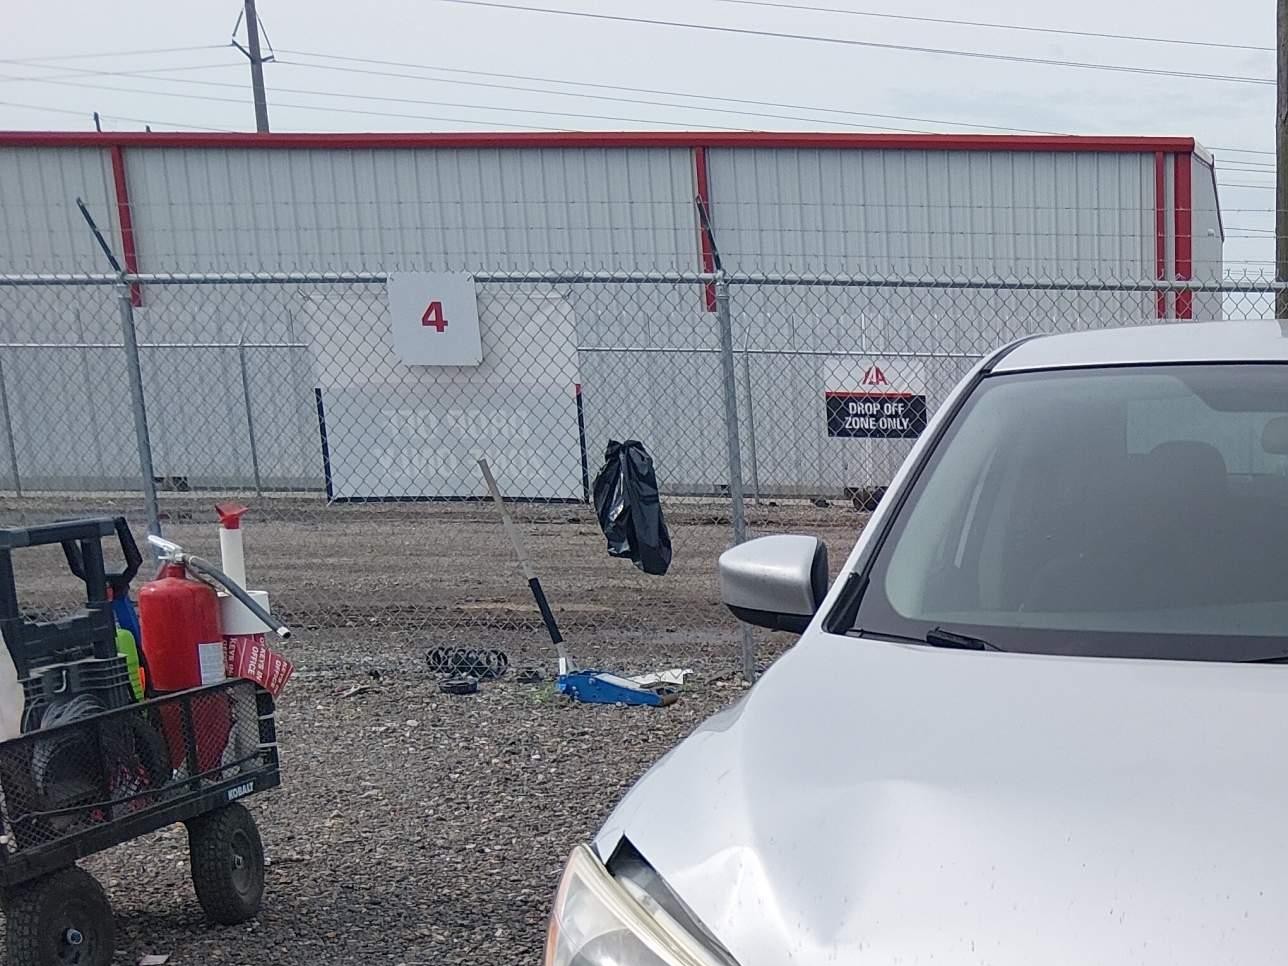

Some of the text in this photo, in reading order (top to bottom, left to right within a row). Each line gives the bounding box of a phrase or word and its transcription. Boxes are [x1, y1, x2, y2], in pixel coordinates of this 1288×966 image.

[422, 301, 449, 333] 4
[848, 402, 905, 416] DROP OFF
[844, 416, 910, 430] ZONE ONLY
[247, 646, 259, 676] OFFICE
[258, 647, 267, 670] KEYS
[256, 670, 263, 681] IN
[227, 781, 255, 801] KOBALT
